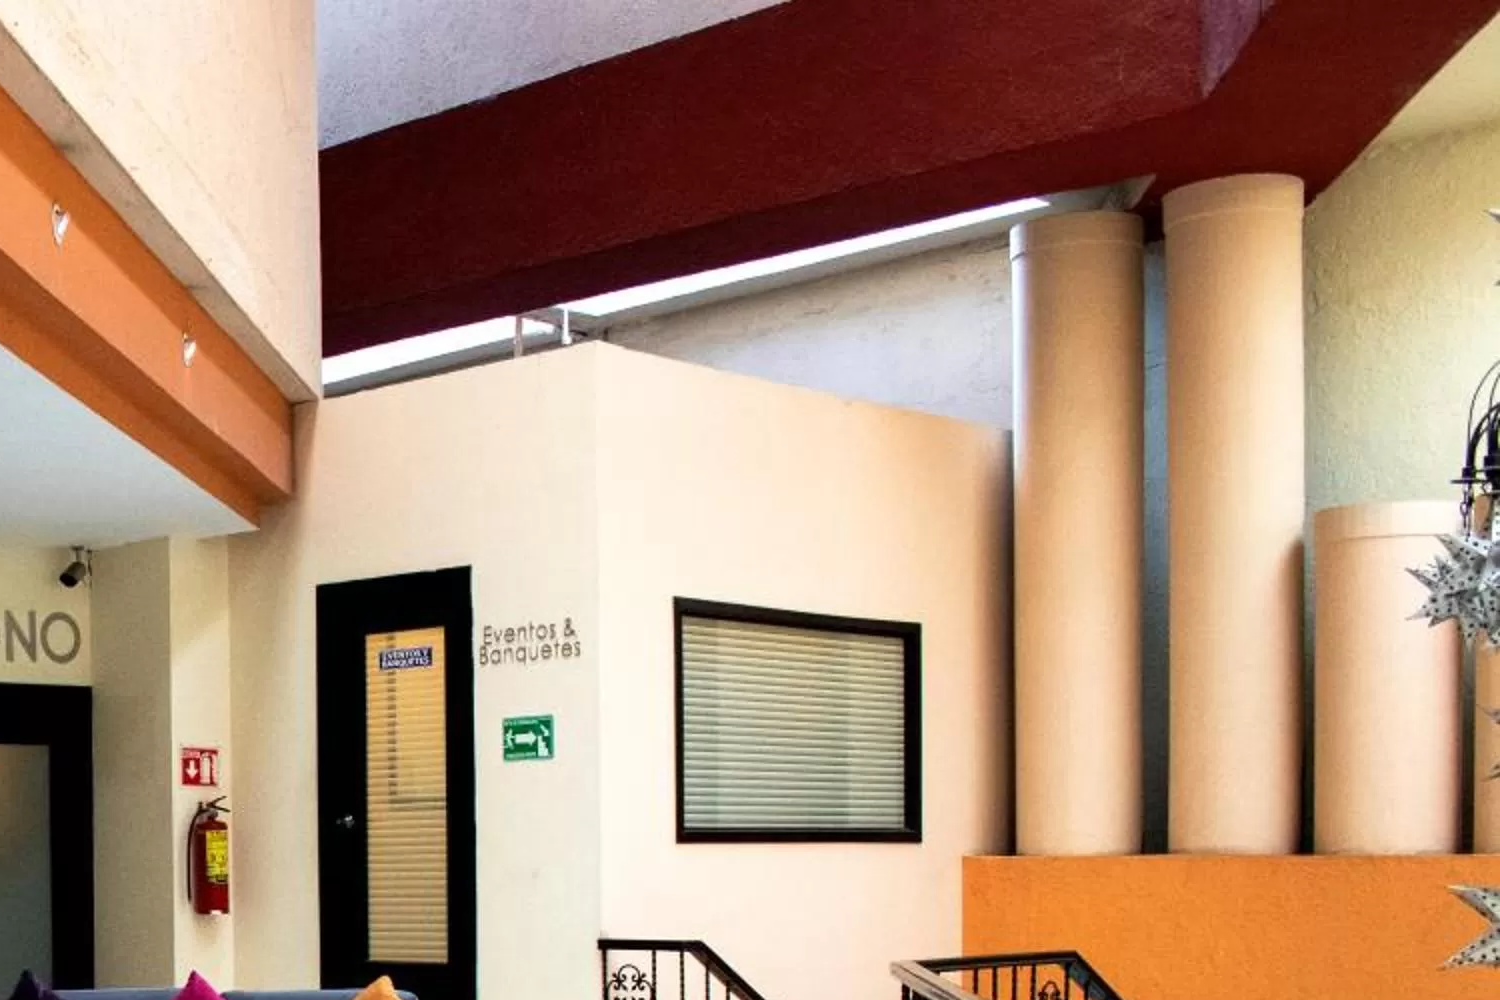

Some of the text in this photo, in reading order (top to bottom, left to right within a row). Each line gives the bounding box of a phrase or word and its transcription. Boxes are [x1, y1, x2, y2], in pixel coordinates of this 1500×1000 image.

[483, 617, 576, 646] Eventos &
[479, 641, 581, 667] Banquetes
